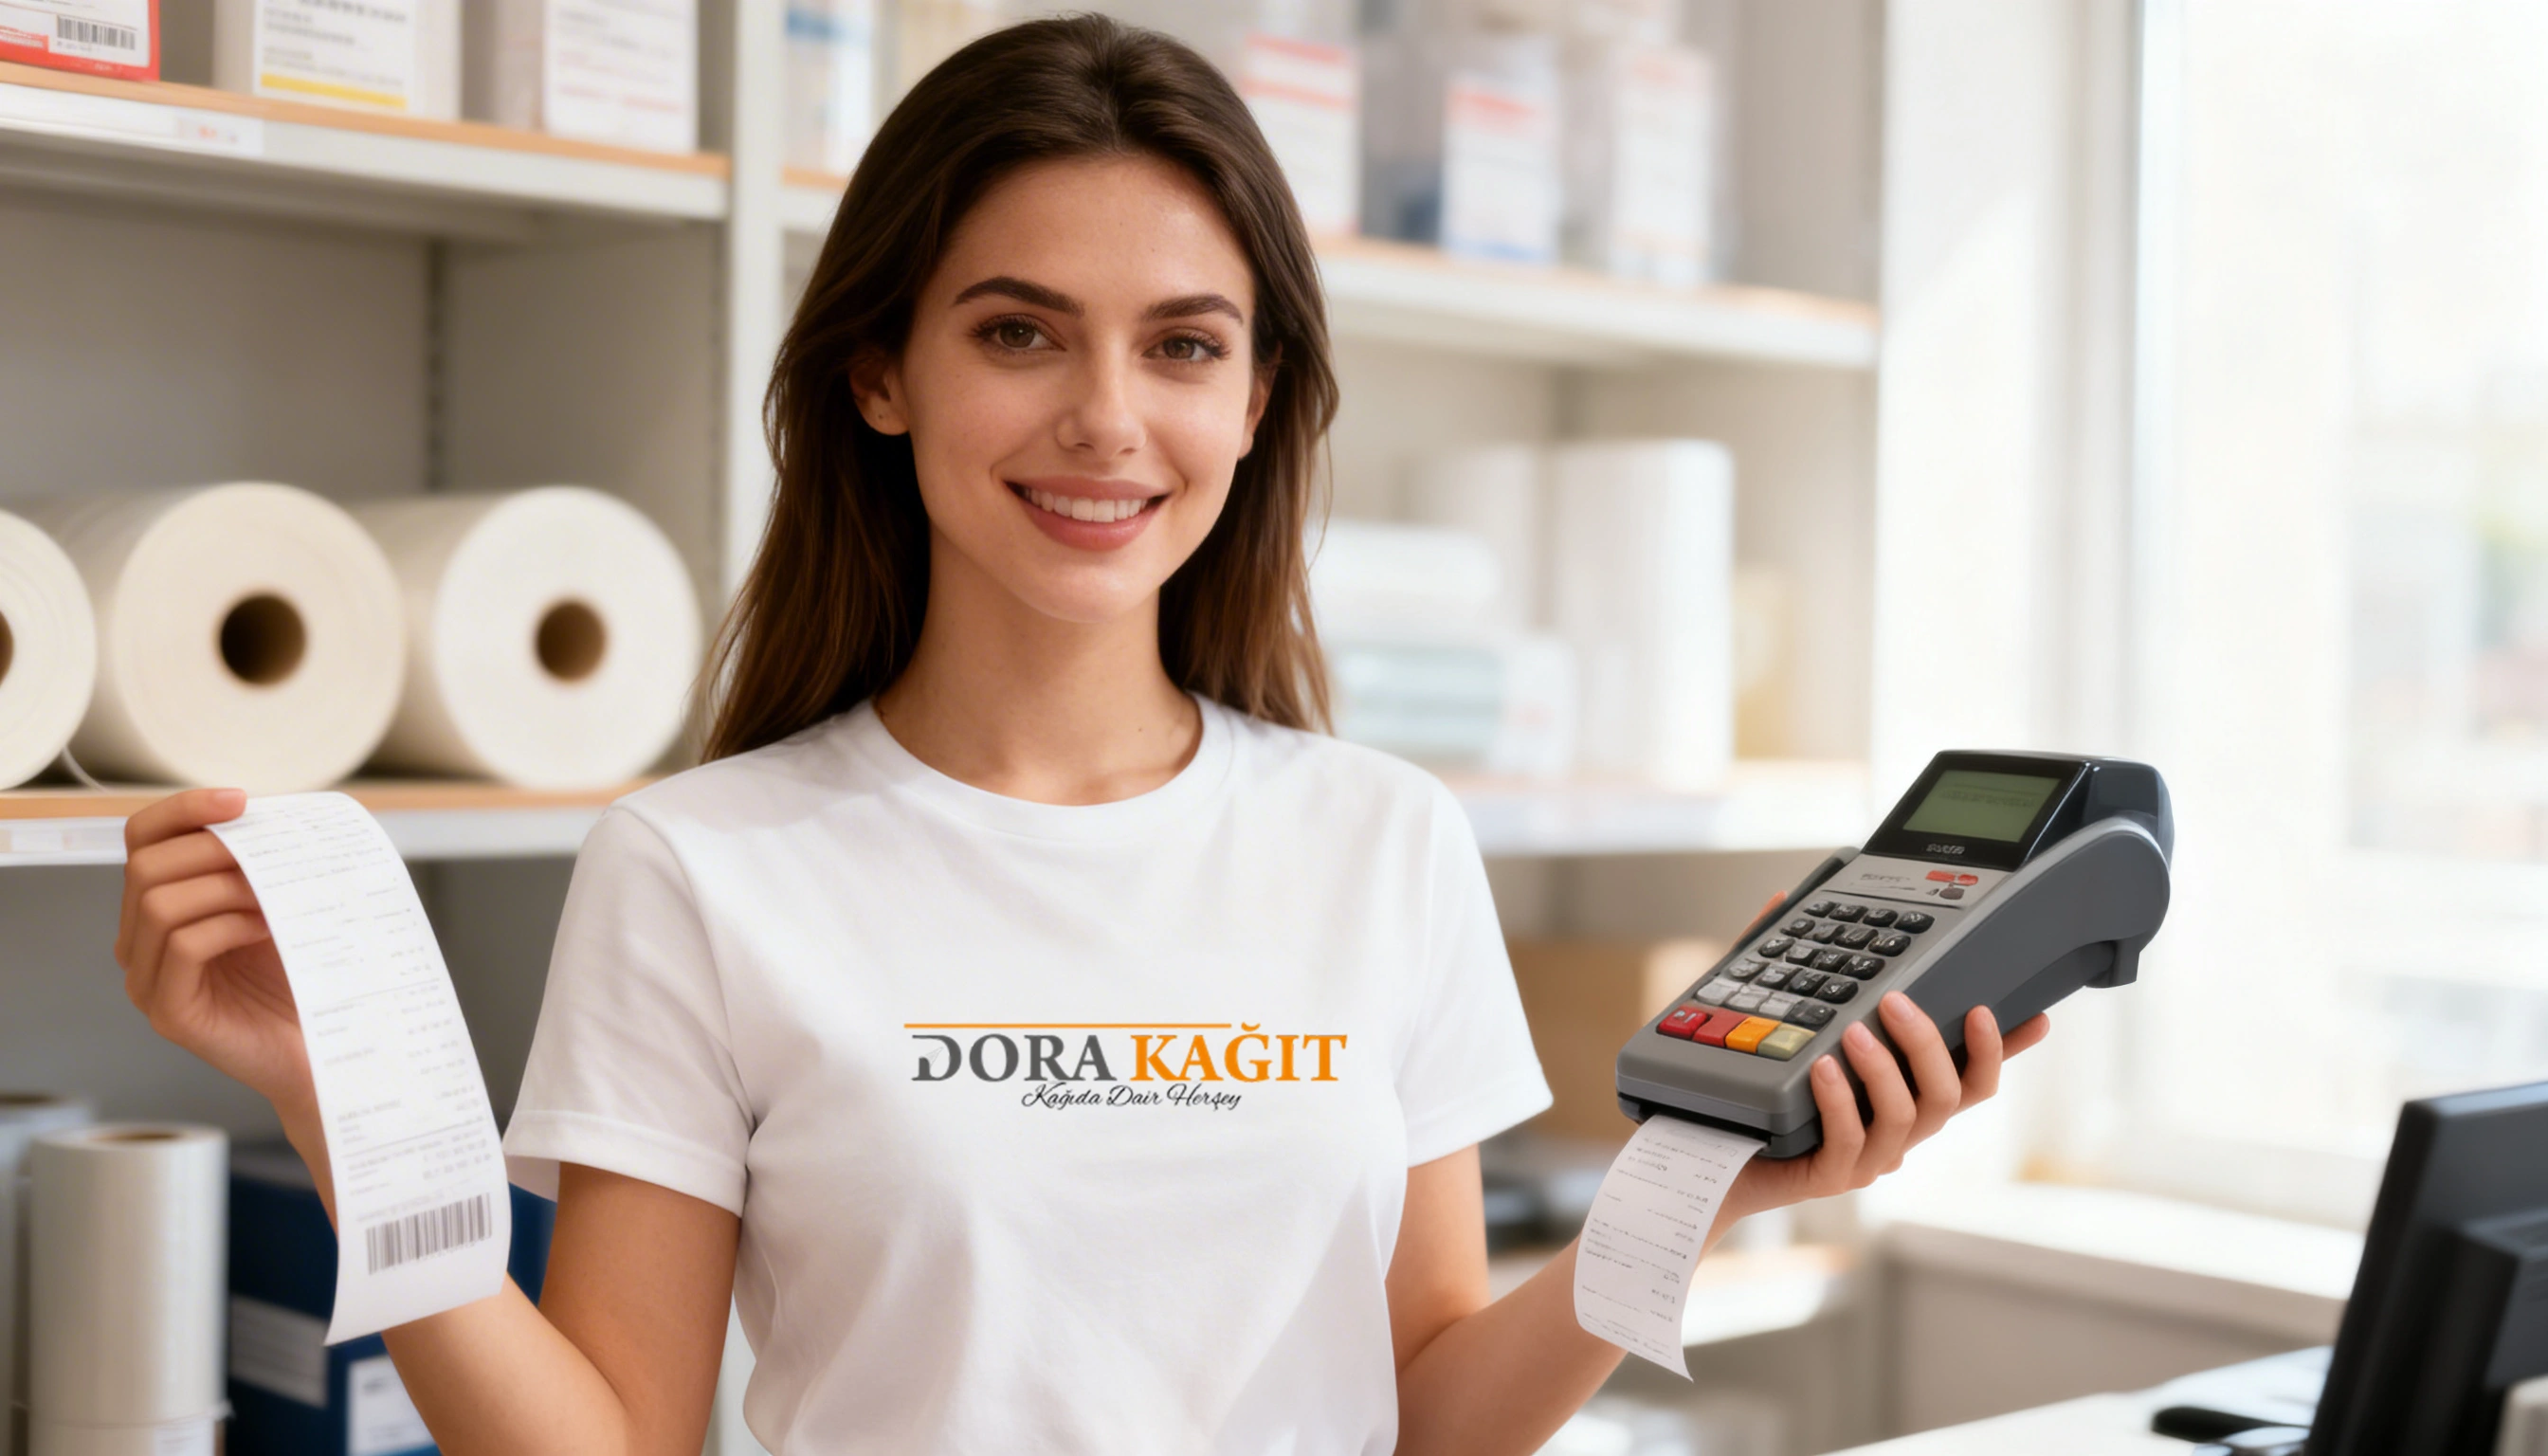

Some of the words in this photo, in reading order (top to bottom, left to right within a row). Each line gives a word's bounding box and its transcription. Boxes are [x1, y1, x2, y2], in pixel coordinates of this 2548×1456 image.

[911, 1033, 1118, 1082] DORA
[1129, 1022, 1348, 1083] KAĞIT
[1021, 1083, 1103, 1110] Kağıda
[1105, 1084, 1162, 1106] Dair
[1166, 1083, 1243, 1112] Herşey
